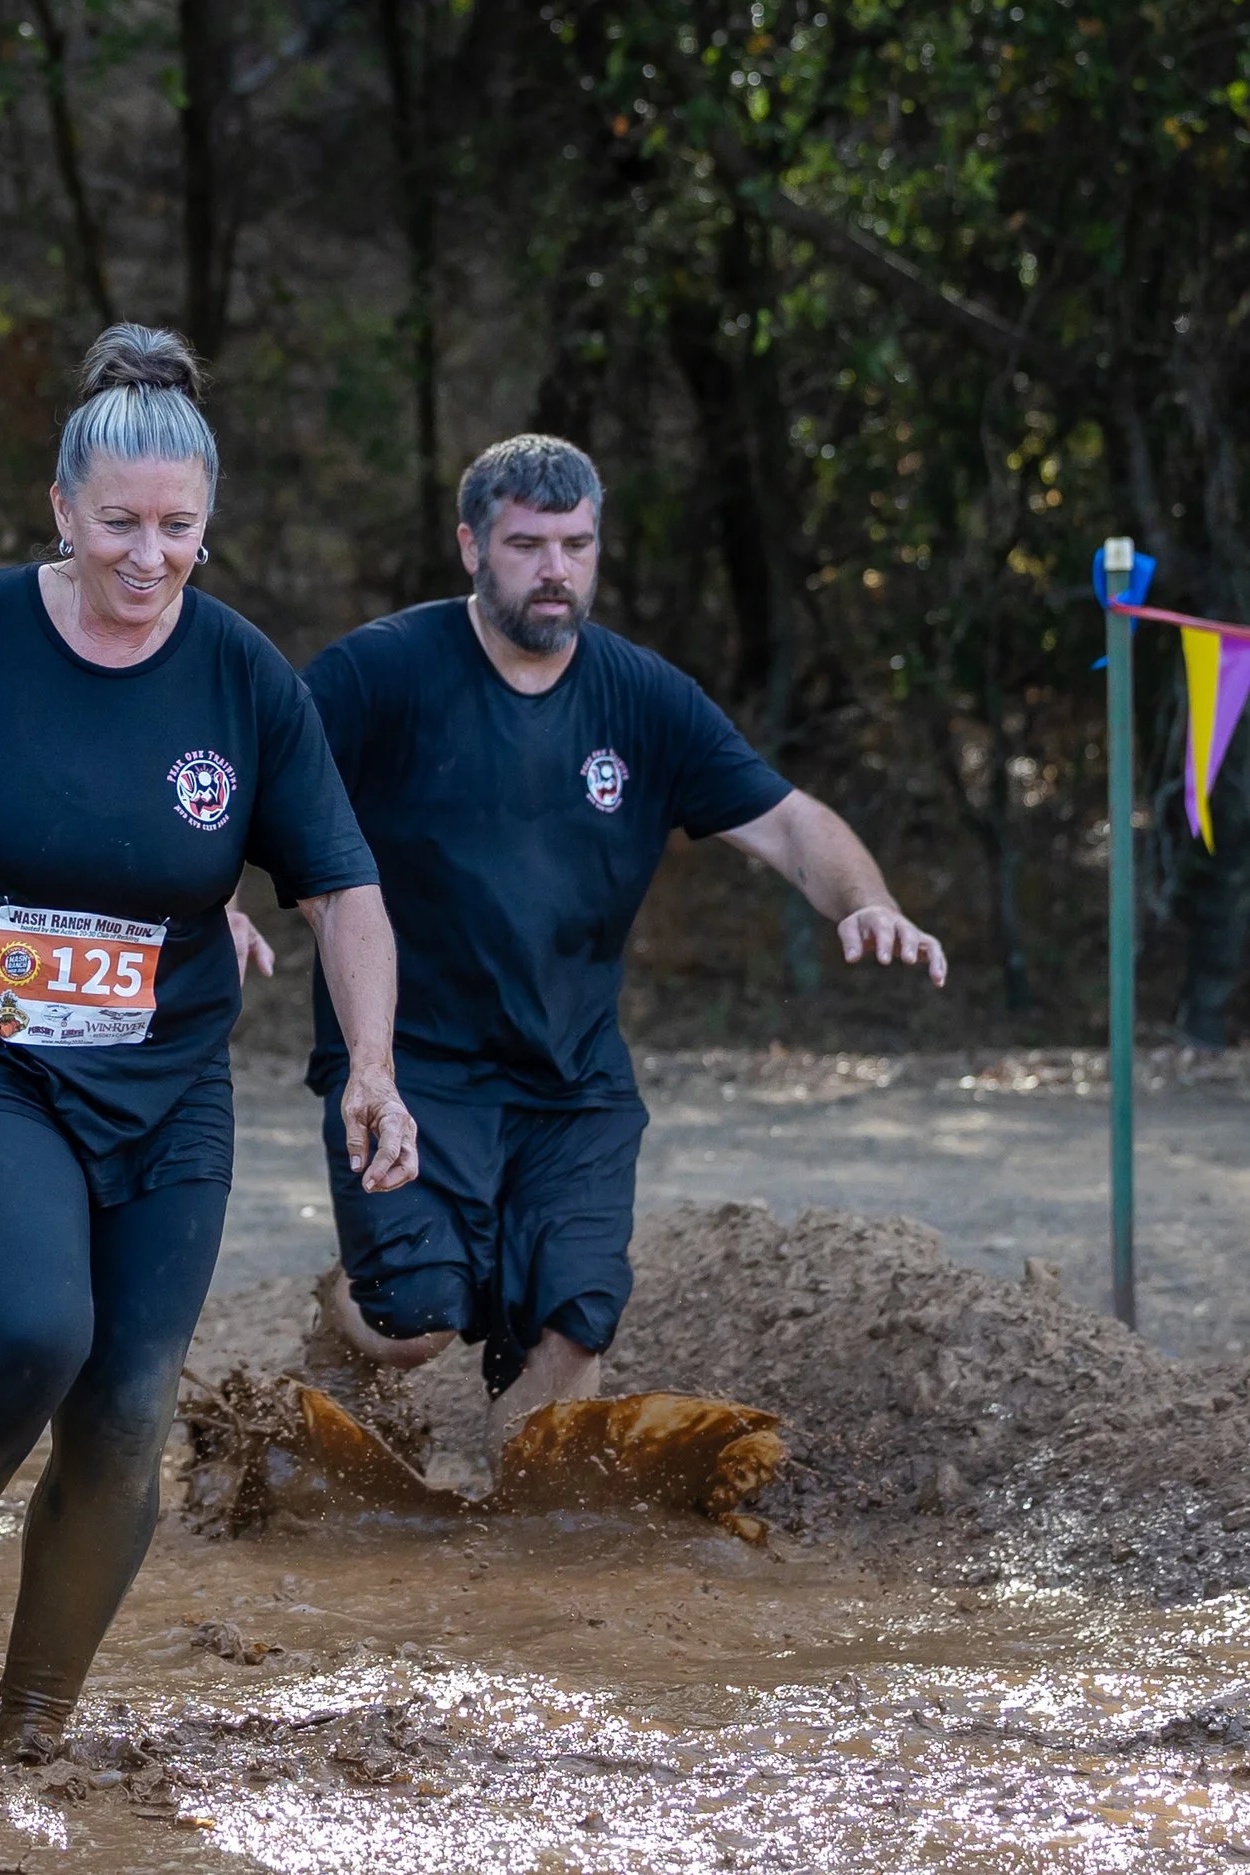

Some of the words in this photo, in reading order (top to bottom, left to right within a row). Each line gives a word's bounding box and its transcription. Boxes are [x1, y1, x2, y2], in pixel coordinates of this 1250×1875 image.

[184, 750, 204, 761] ONE
[208, 750, 238, 791] TRAINING
[13, 910, 47, 926] NASH
[51, 914, 92, 931] RANCH
[95, 919, 122, 934] MUD
[125, 924, 151, 937] RUN
[47, 946, 144, 998] 125
